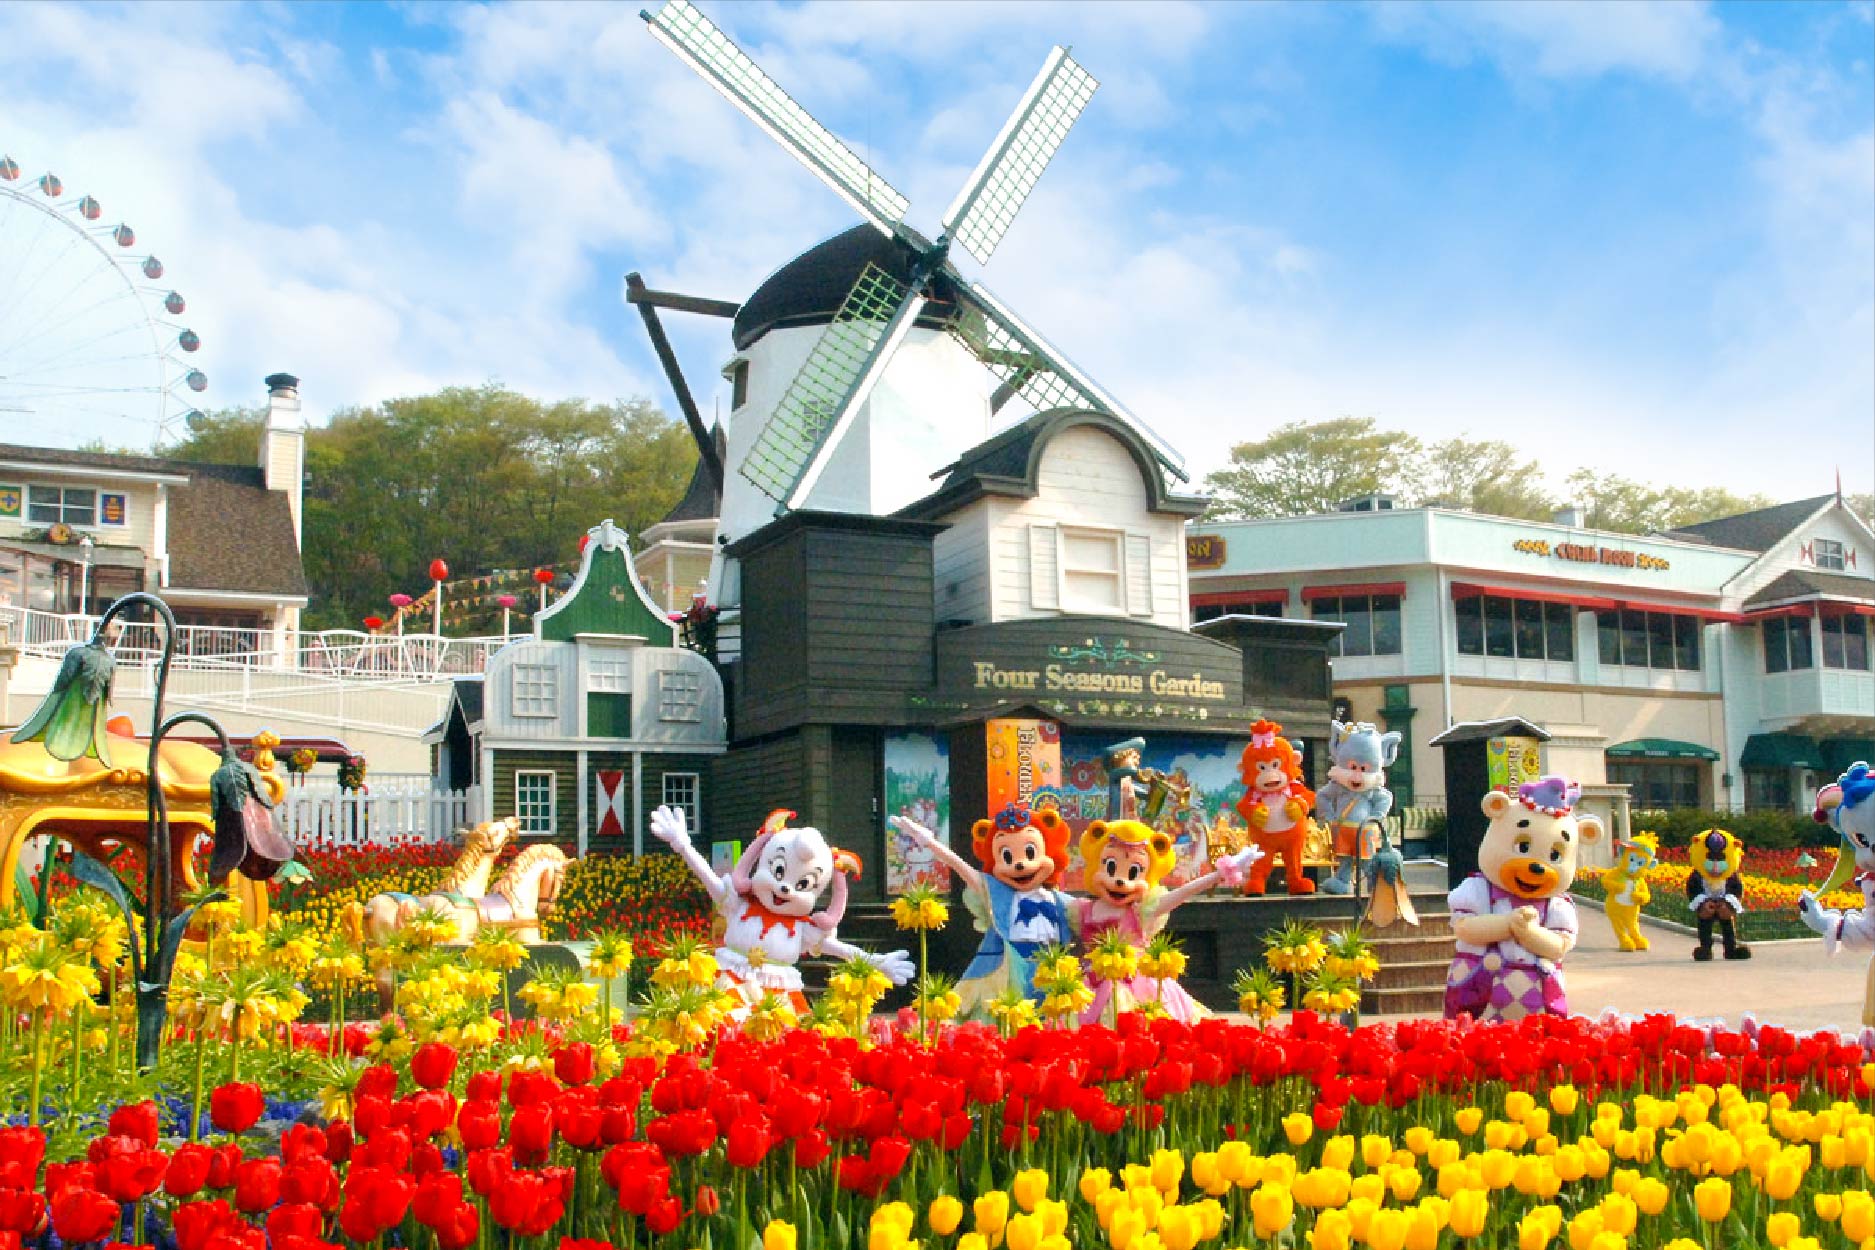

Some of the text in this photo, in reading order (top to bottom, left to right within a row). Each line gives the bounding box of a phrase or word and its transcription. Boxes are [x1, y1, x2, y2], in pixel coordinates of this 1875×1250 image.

[974, 661, 1225, 699] Four Seasons Garden
